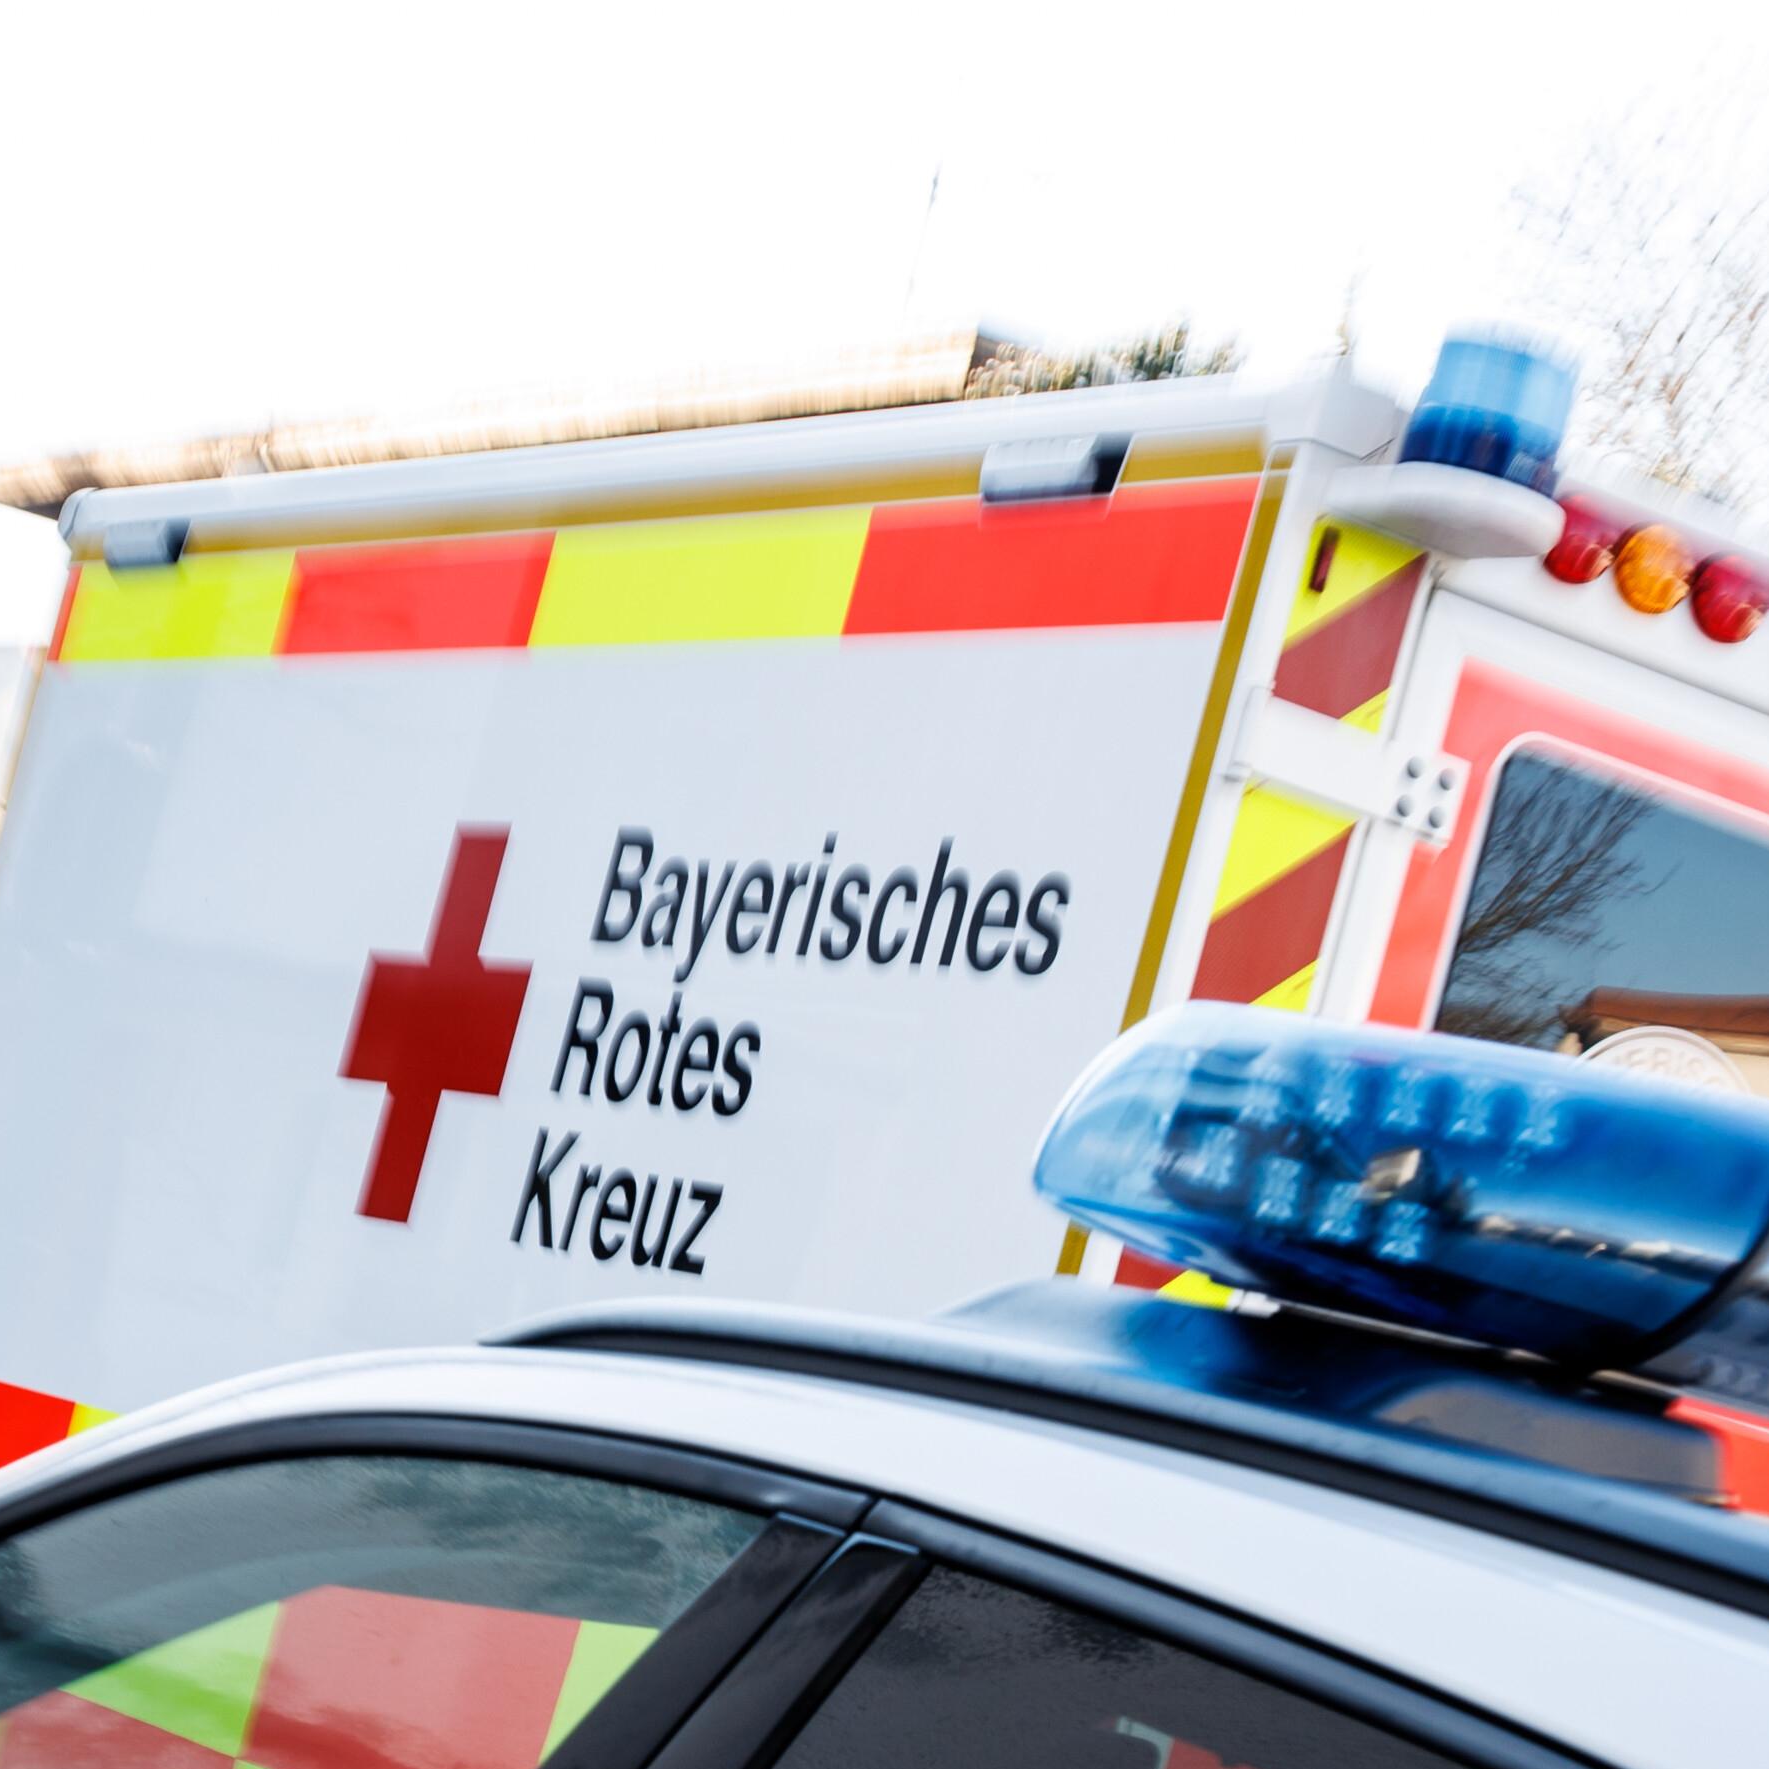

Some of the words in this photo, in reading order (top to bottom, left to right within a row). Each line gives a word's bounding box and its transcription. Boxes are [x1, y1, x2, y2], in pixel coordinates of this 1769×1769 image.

[590, 825, 1072, 983] Bayerisches
[551, 976, 762, 1116] Rotes
[510, 1126, 725, 1275] Kreuz
